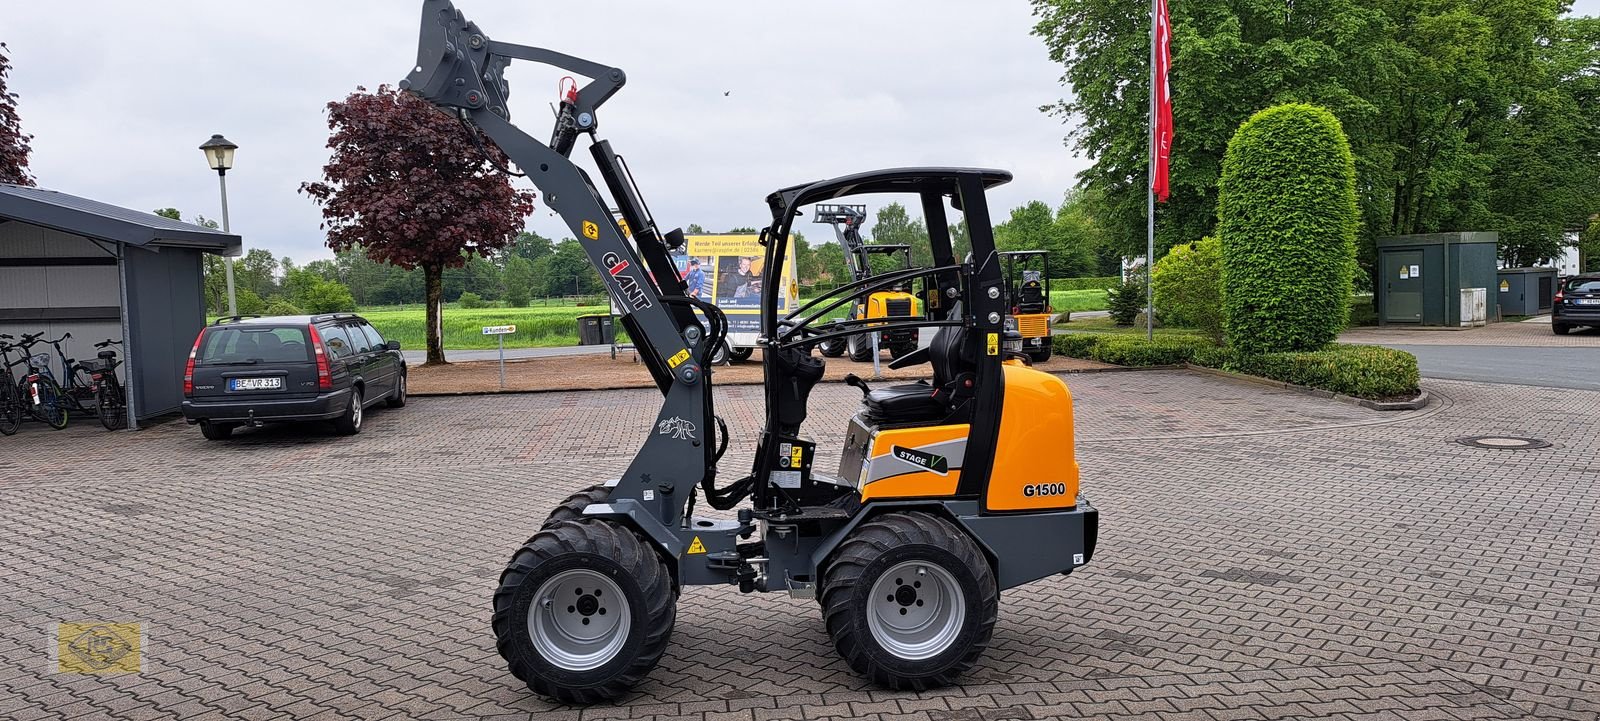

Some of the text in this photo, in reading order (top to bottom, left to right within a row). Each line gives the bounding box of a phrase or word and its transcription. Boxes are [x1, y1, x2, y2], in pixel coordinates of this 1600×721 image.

[602, 252, 652, 311] GIANT
[236, 378, 280, 388] BE VR 313
[900, 451, 927, 466] STAGE
[1023, 482, 1066, 497] G1500
